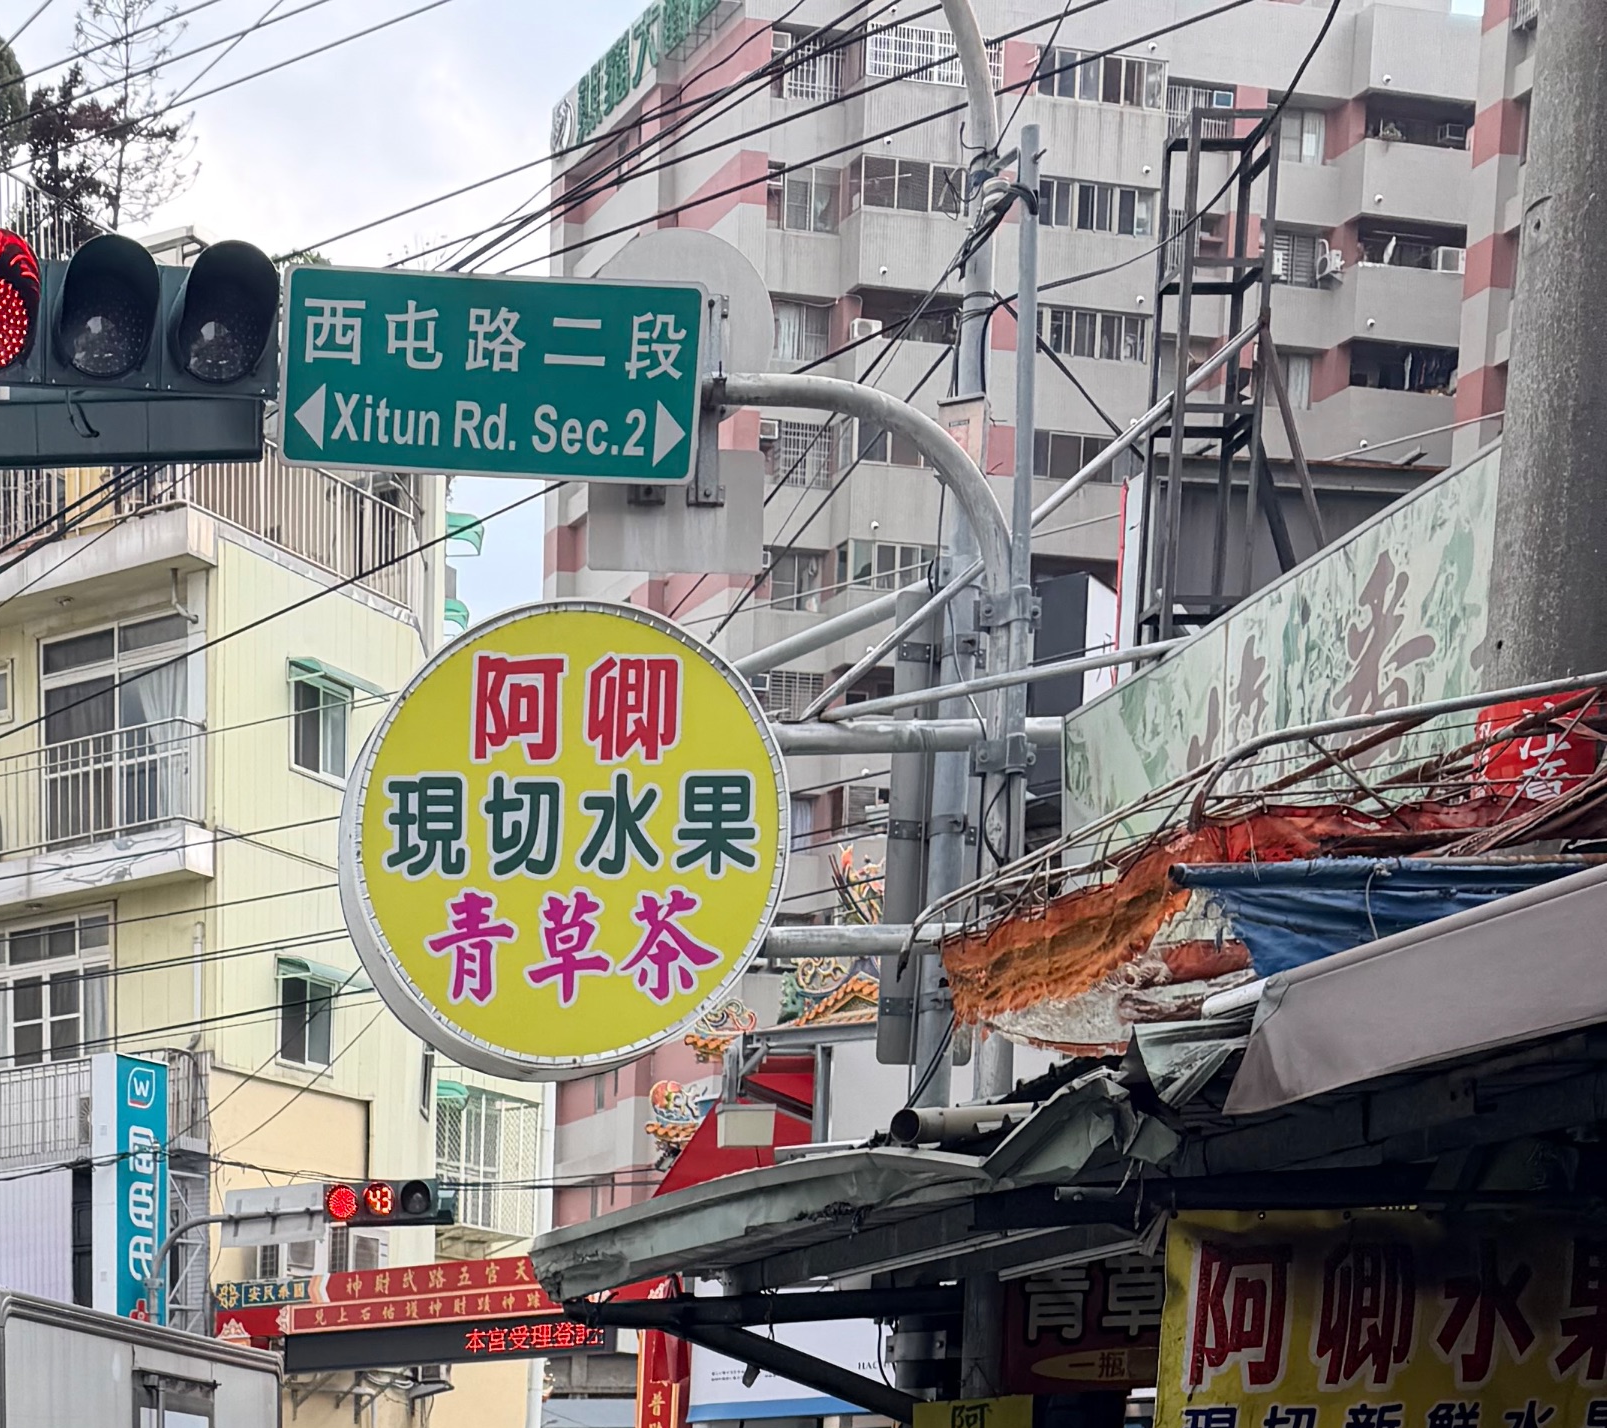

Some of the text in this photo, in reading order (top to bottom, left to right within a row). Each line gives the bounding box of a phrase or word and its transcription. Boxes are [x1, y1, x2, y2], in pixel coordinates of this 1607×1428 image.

[304, 297, 688, 382] 西屯路二段
[330, 392, 647, 460] Xitun Rd. Sec.2
[470, 652, 682, 764] 阿卿
[384, 772, 759, 880] 現切水果
[426, 889, 722, 1006] 青草茶
[367, 1186, 392, 1214] 43
